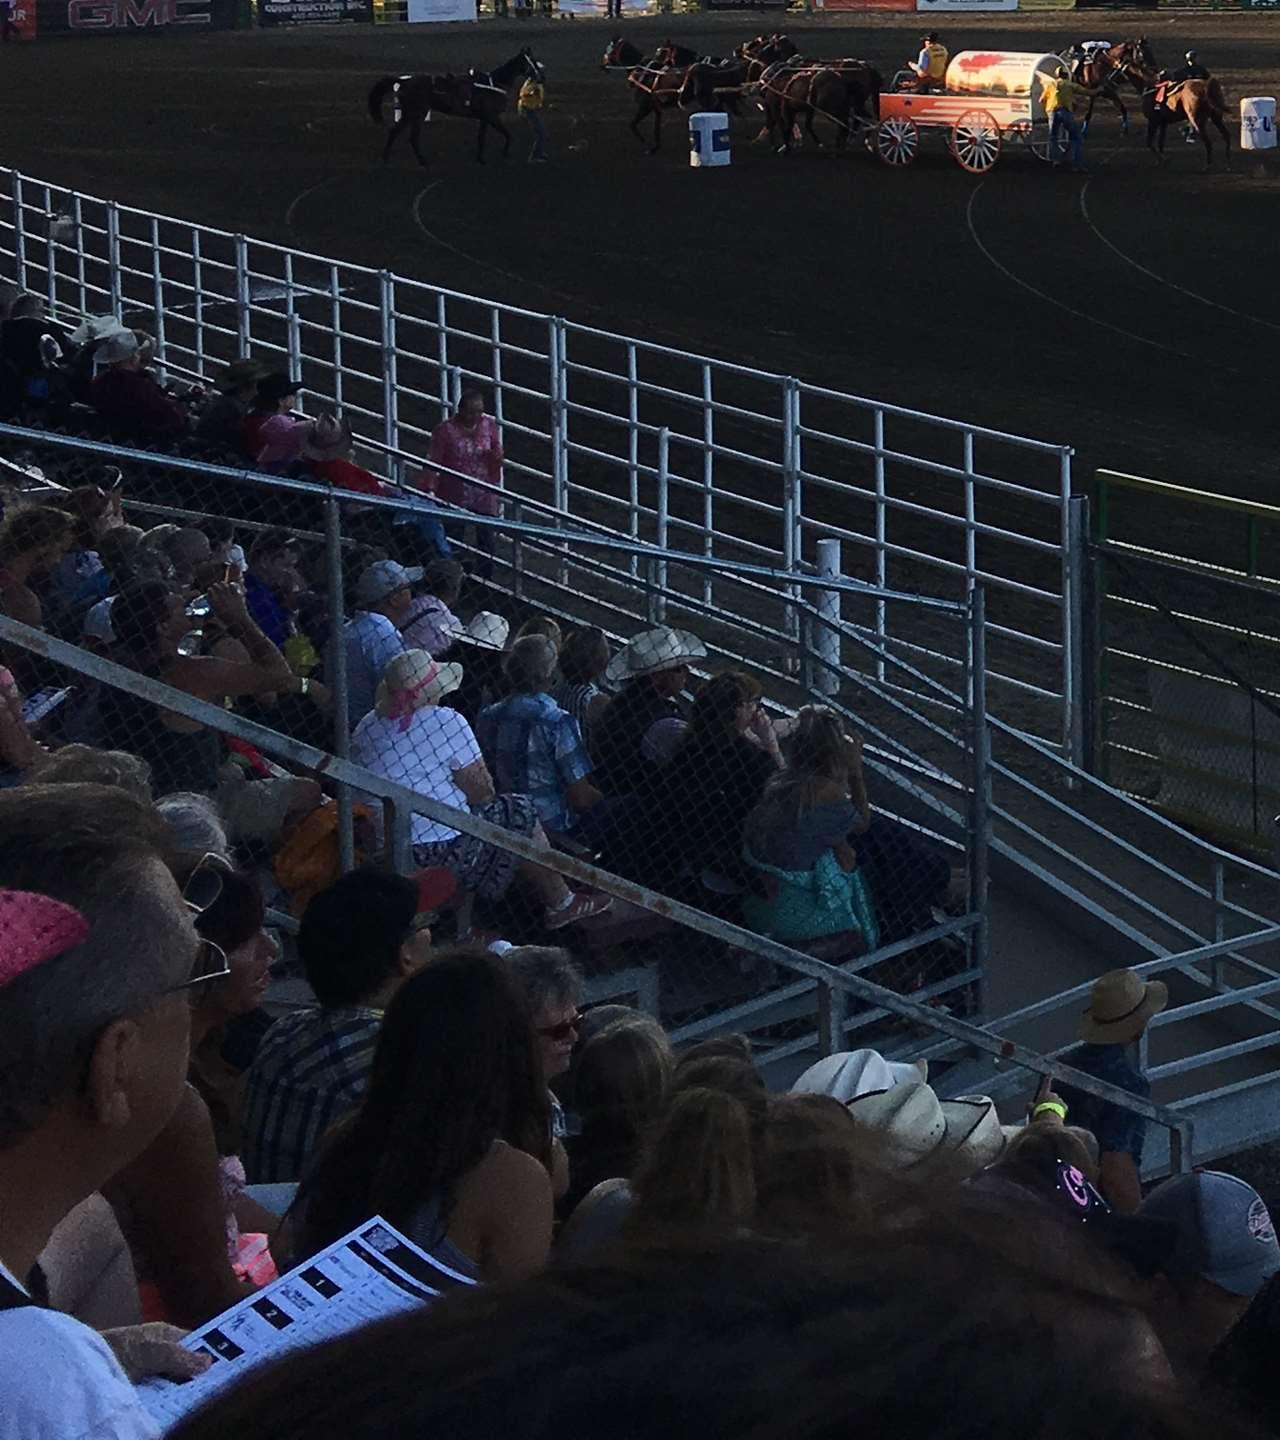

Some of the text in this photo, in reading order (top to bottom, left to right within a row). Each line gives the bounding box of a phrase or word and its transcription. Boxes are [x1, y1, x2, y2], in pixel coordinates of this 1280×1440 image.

[315, 1277, 326, 1288] 1
[266, 1307, 279, 1319] 2
[217, 1341, 229, 1352] 3
